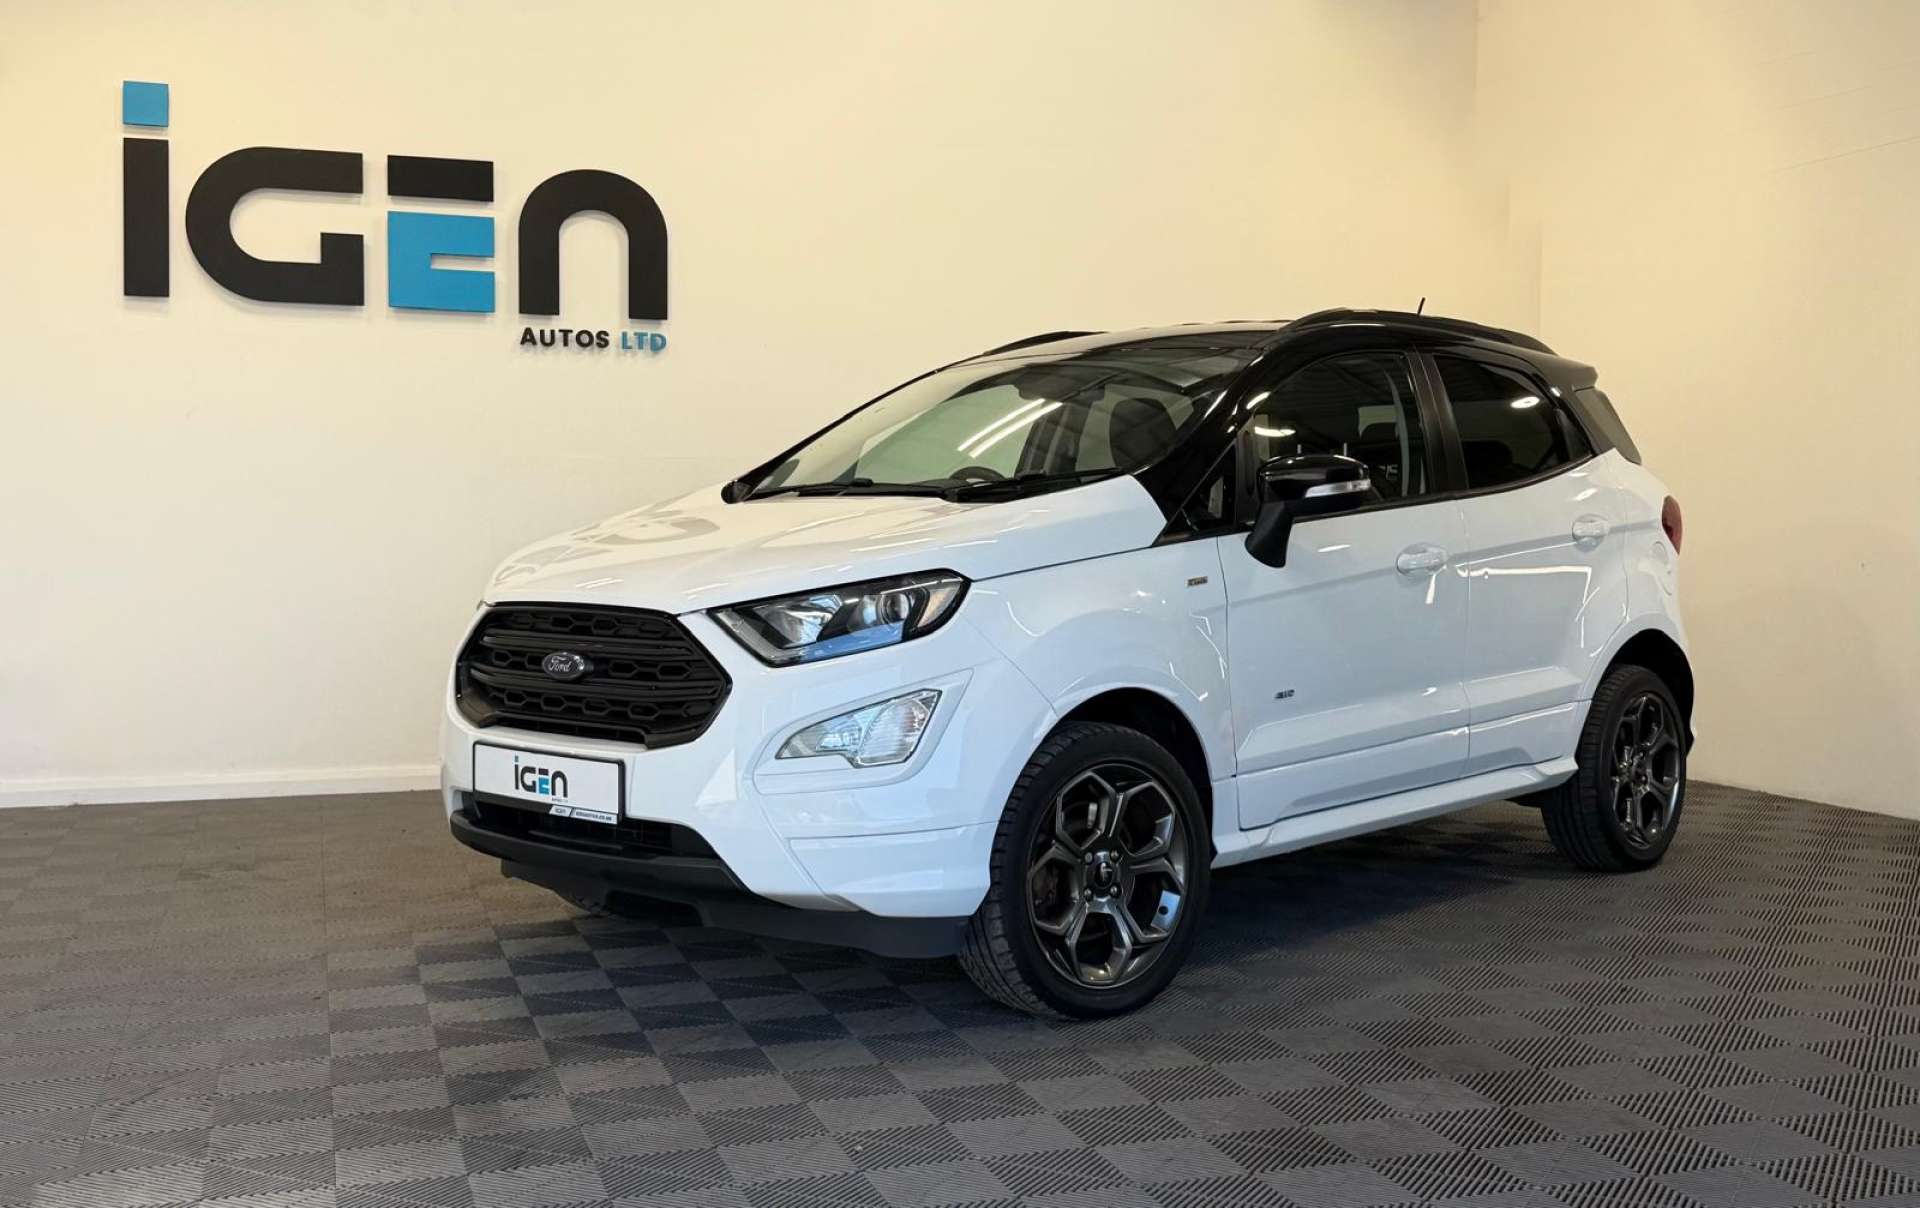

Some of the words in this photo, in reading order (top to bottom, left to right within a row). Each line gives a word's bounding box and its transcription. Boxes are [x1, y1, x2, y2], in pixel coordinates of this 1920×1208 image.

[520, 327, 610, 349] AUTOS
[621, 331, 667, 352] LTD
[549, 655, 573, 672] Ford
